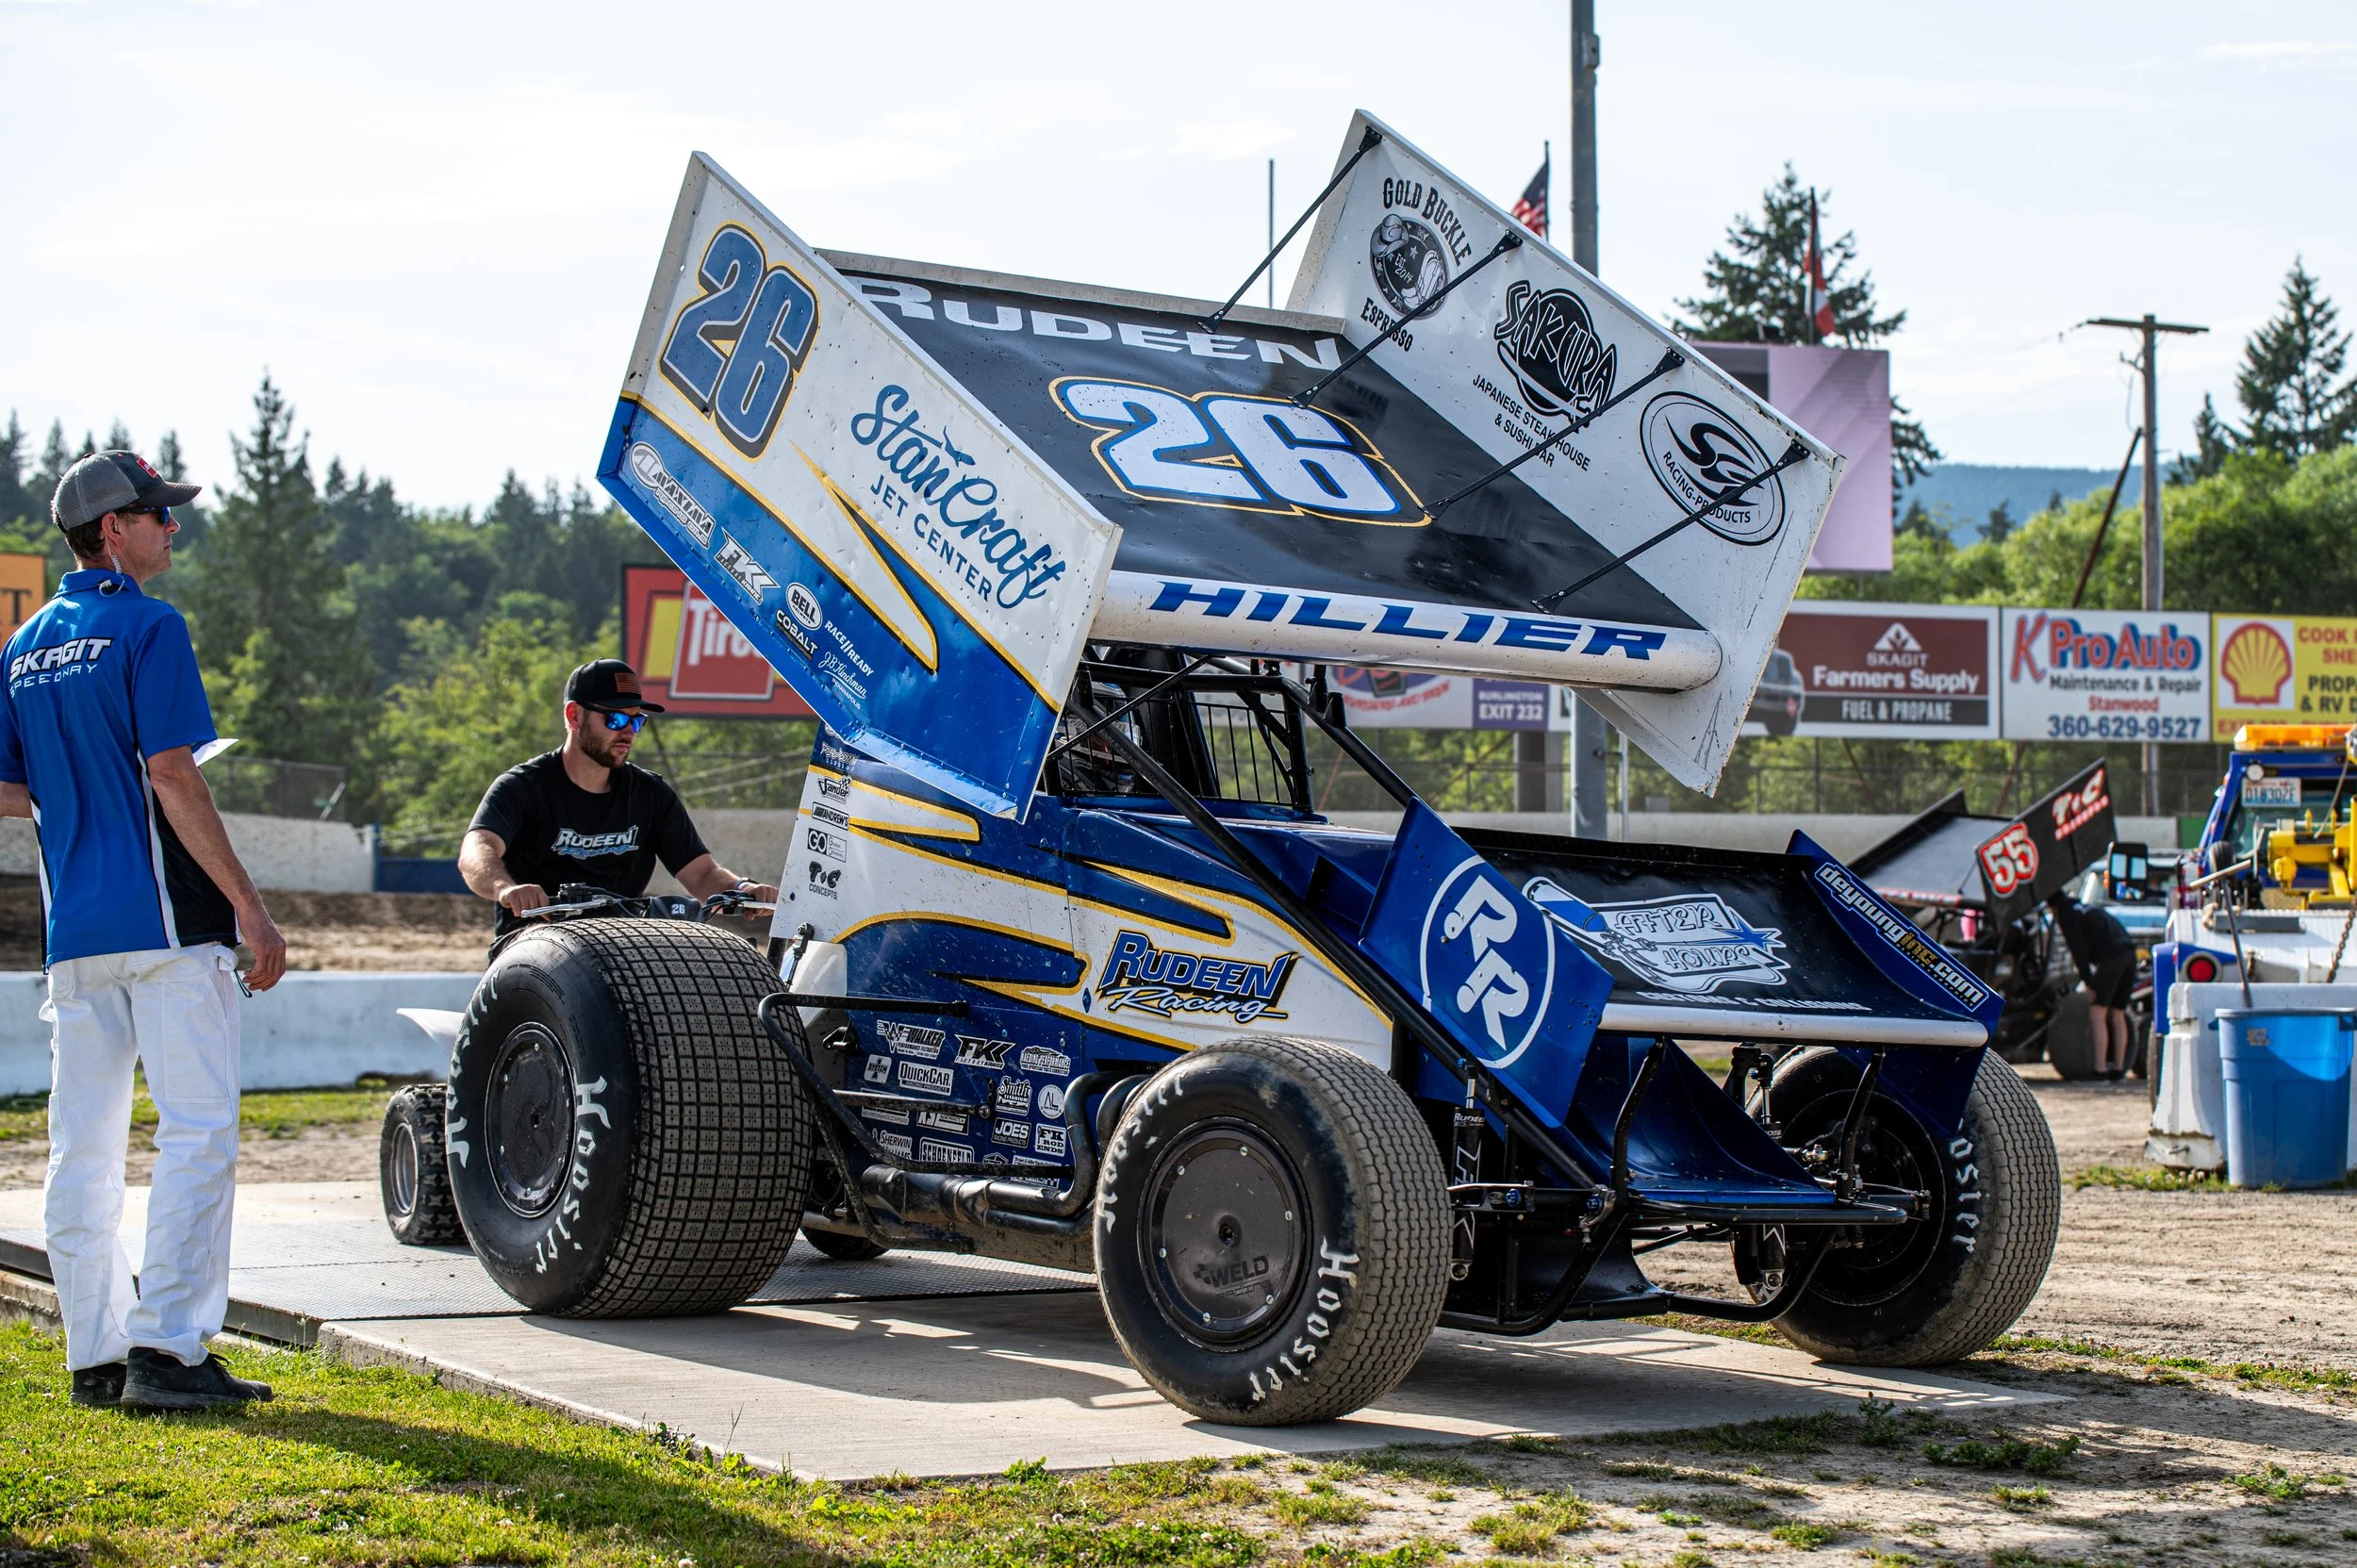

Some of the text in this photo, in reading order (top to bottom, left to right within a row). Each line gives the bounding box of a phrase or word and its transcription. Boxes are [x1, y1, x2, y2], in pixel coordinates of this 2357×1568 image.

[1383, 177, 1472, 267] GOLD BUCKLE
[856, 277, 1341, 370] RUDEEN
[660, 223, 819, 461] 26
[1493, 280, 1617, 416] SAKURA
[1473, 374, 1523, 419] JAPANESE
[1494, 414, 1502, 426] &
[1504, 420, 1534, 451] SUSHI
[1051, 378, 1419, 521] 26
[655, 488, 687, 525] RACING
[870, 474, 993, 602] JET CENTER
[792, 589, 816, 623] BELL
[1149, 580, 1667, 660] HILLIER
[777, 610, 817, 654] COBALT
[2299, 626, 2347, 643] COOK
[10, 639, 111, 683] SKAGIT
[1867, 652, 1929, 667] SKAGIT
[1813, 666, 1978, 694] Farmers Supply
[2050, 674, 2201, 696] Maintenance & Repair
[1478, 705, 1543, 721] EXIT 232
[1841, 701, 1952, 721] FUEL & PROPANE
[2088, 694, 2159, 712] Stanwood
[2300, 697, 2313, 713] &
[2319, 696, 2344, 712] RV
[2048, 715, 2201, 738] 360-629-9527
[554, 826, 637, 850] RUDEEN
[1980, 822, 2039, 898] 55
[809, 883, 837, 900] CONCEPTS
[671, 903, 685, 915] 26
[1615, 903, 1720, 934] AFTER
[1820, 867, 1984, 1004] deyounginc.com
[1098, 930, 1297, 999] RUDEEN
[1107, 986, 1288, 1023] Racing
[906, 1027, 943, 1047] WALKER
[999, 1077, 1030, 1097] Smith
[880, 1131, 912, 1149] SHERWIN
[994, 1134, 1027, 1146] RACING PRODUCTS
[995, 1121, 1030, 1139] JOES
[1039, 1129, 1063, 1141] FK
[1043, 1139, 1063, 1147] ROD
[1036, 1145, 1063, 1154] ENDS
[536, 1075, 613, 1274] Hoosier
[1210, 1255, 1269, 1287] WELD
[1216, 1279, 1271, 1297] RACING
[1249, 1236, 1360, 1403] Hoosier
